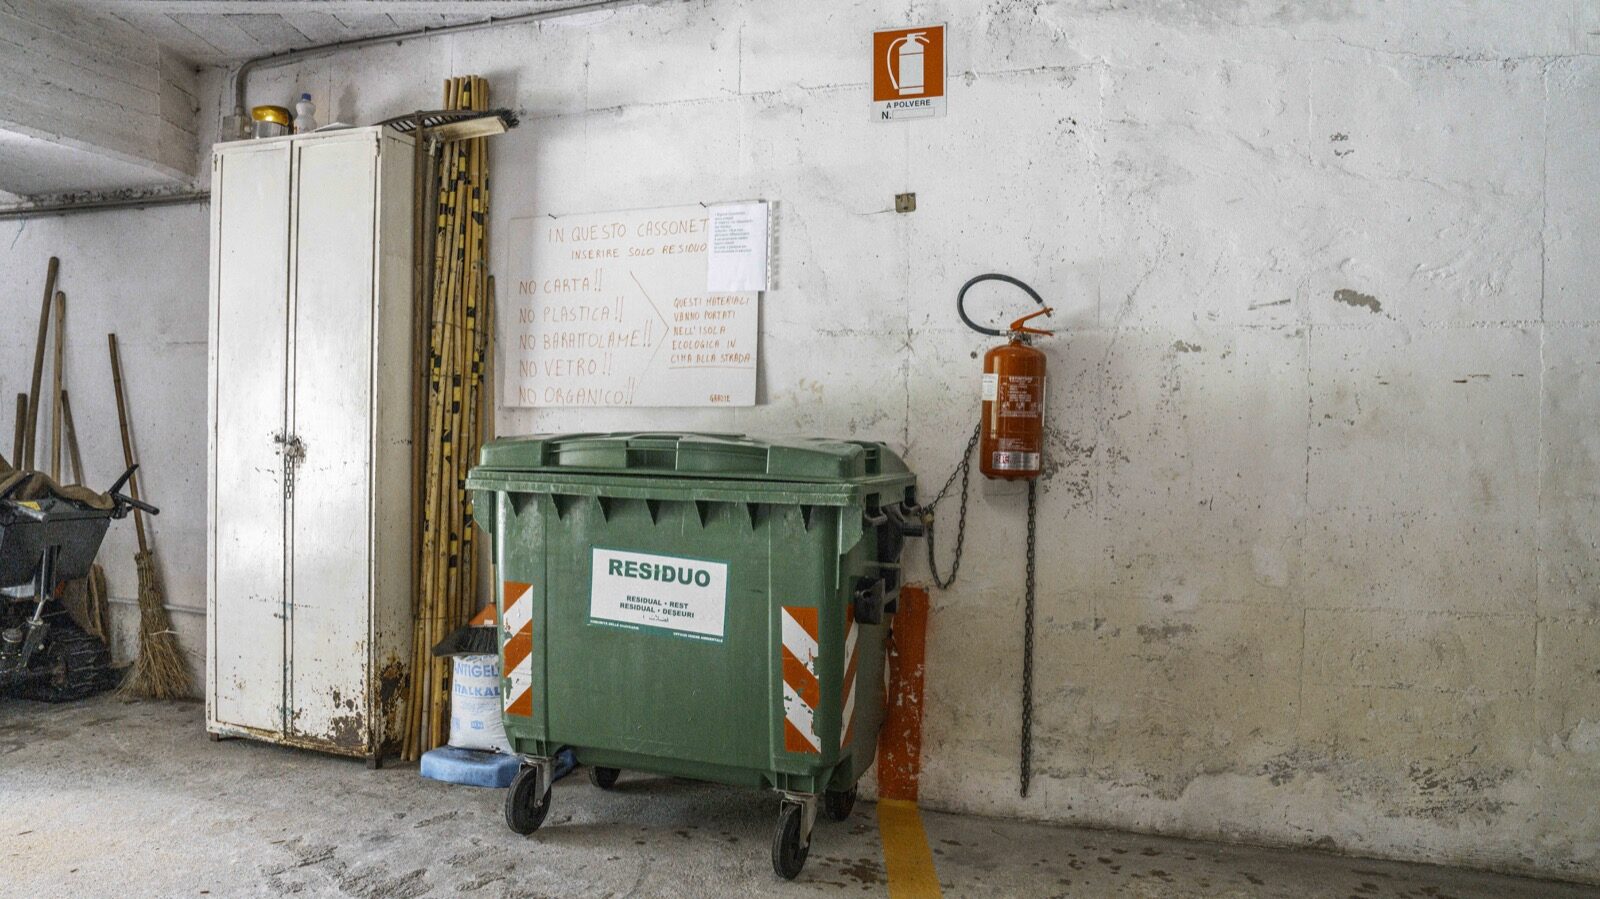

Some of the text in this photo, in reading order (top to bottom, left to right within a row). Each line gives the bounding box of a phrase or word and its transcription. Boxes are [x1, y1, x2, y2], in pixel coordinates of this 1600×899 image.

[893, 99, 931, 108] POLVERE
[881, 111, 892, 120] N.
[548, 227, 564, 243] IN
[571, 222, 627, 242] QUESTO
[571, 242, 708, 260] INSERIRE SOLO RESIDUO
[519, 279, 537, 295] NO
[673, 295, 750, 310] QUESTI MATERIALI
[519, 307, 536, 323] NO
[673, 310, 736, 322] VANNO PORTATI
[519, 333, 536, 350] NO
[672, 339, 737, 350] ECOLOGICA IN
[670, 352, 751, 364] CIMA ALLA STRADA
[519, 359, 538, 377] NO
[519, 385, 537, 404] NO
[608, 558, 711, 587] RESIDUO
[619, 602, 655, 613] RESIDUAL
[626, 595, 688, 609] RESIDUAL REST
